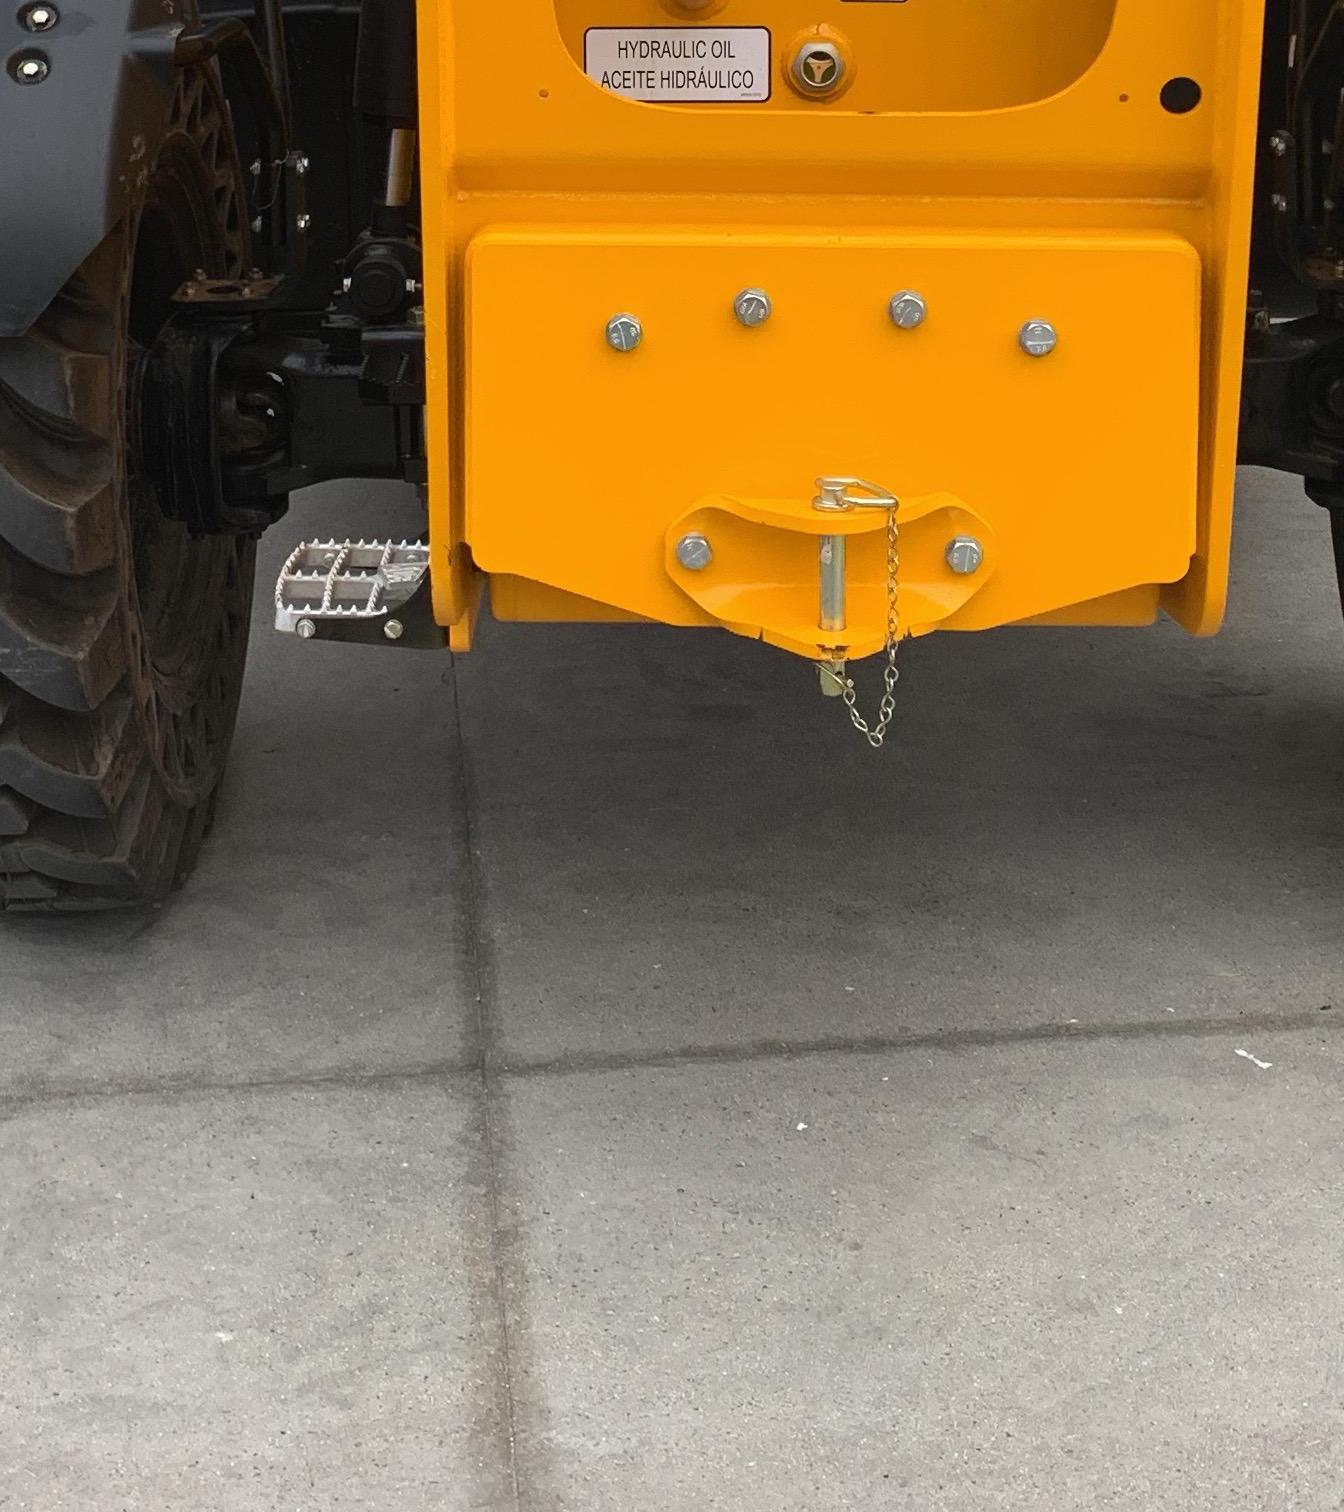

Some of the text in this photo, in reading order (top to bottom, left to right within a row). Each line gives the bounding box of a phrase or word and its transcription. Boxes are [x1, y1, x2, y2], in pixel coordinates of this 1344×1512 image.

[617, 40, 736, 59] HYDRAULIC OIL
[601, 65, 754, 89] ACEITE HIDRÁULICO
